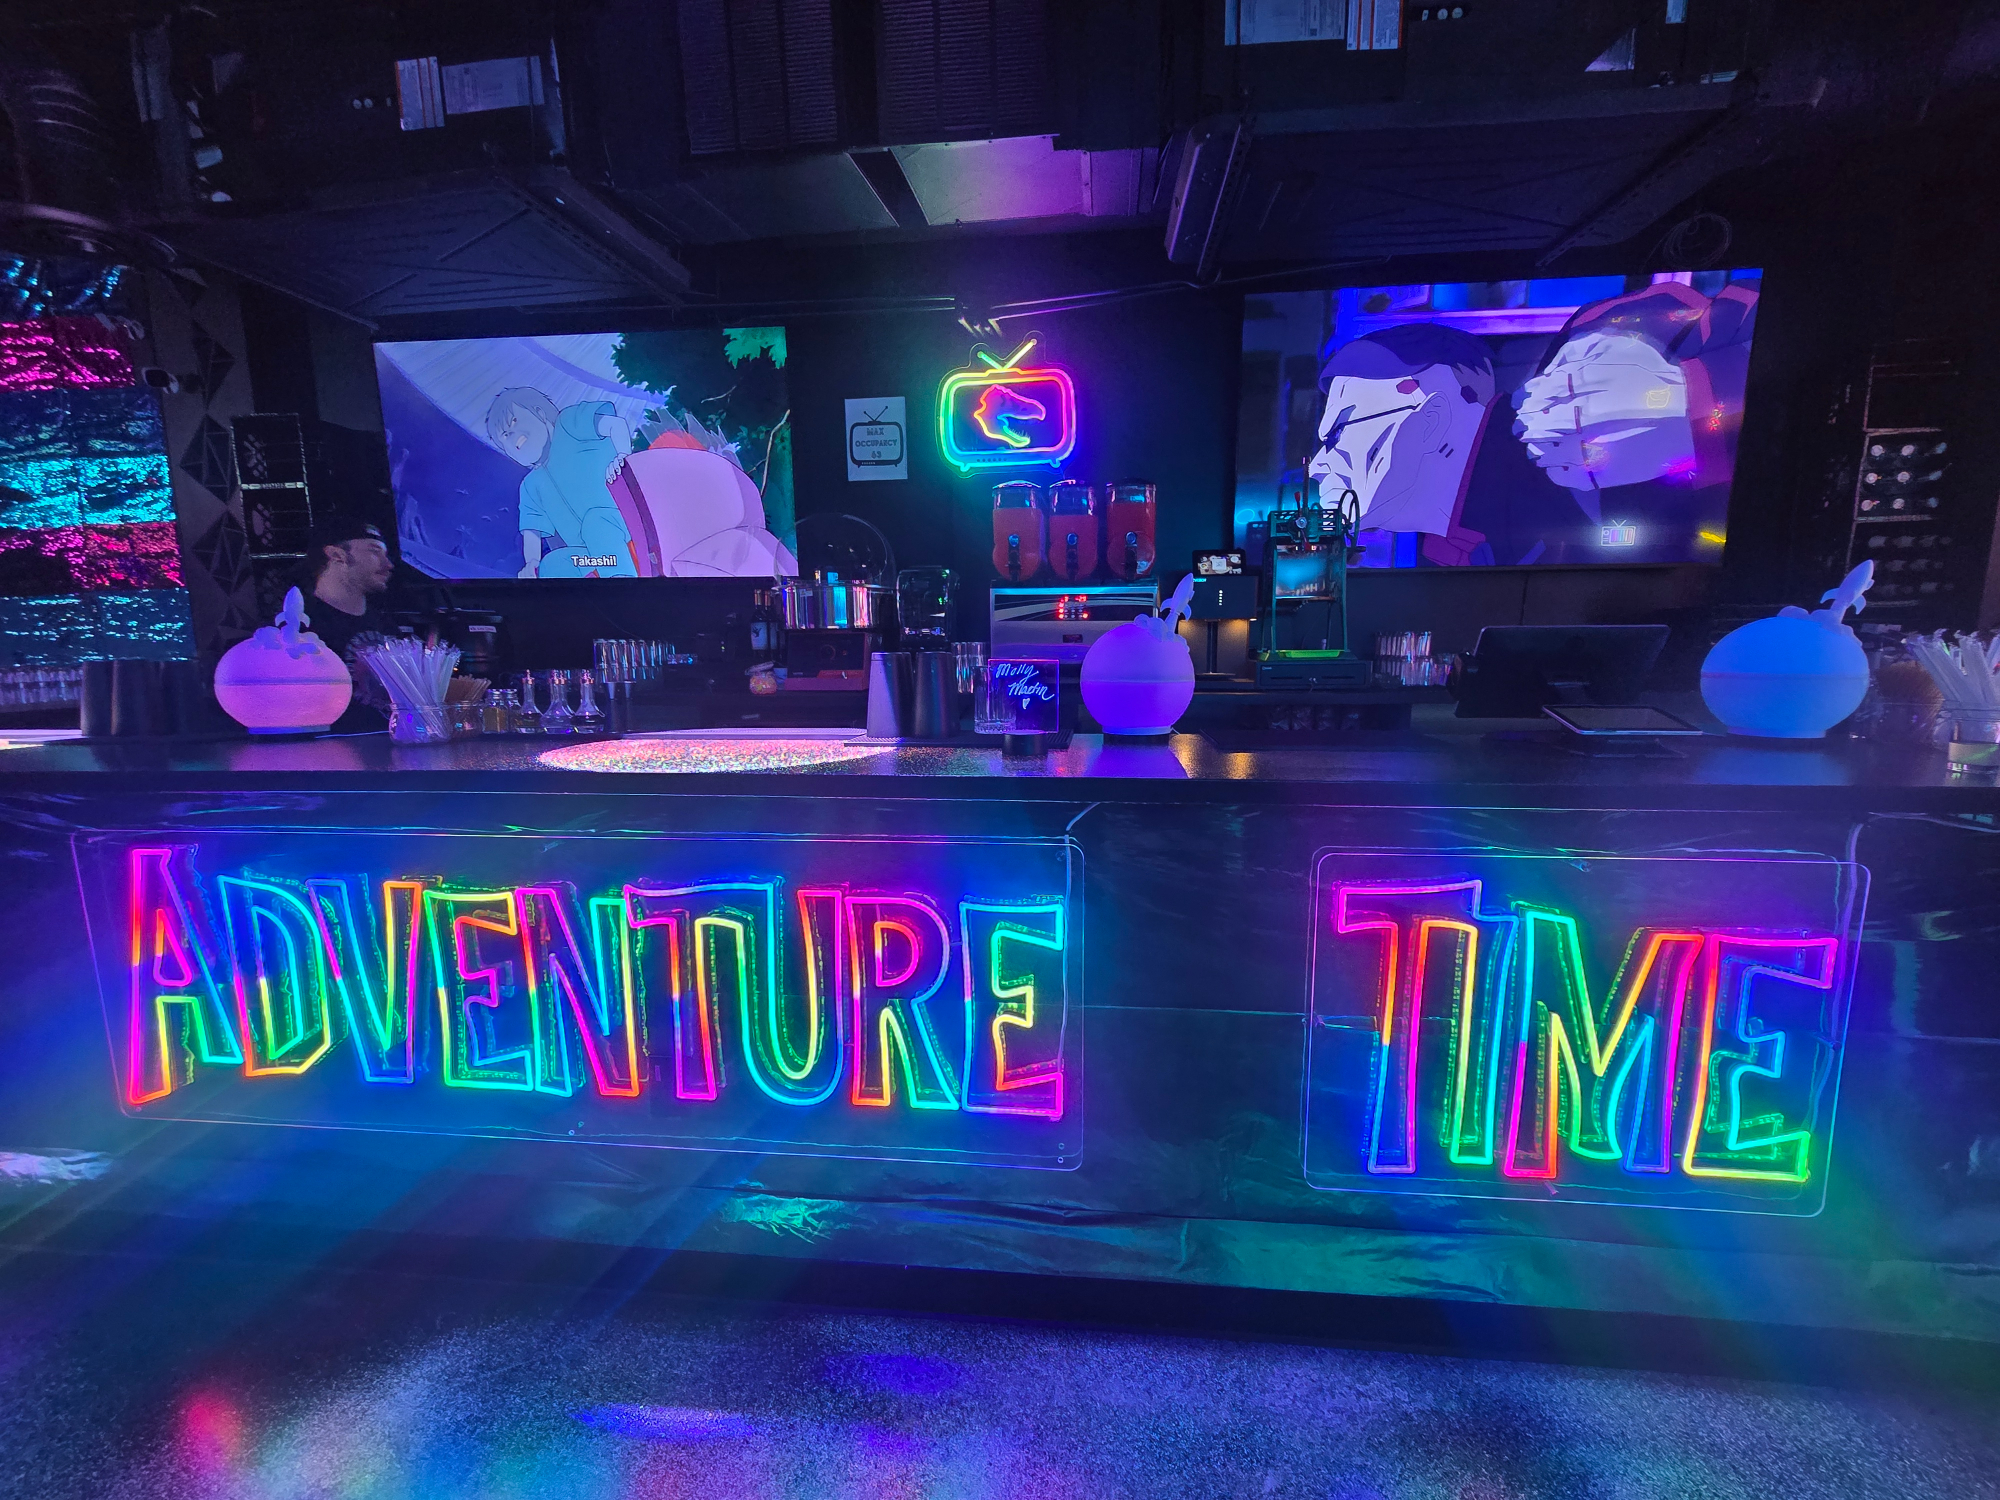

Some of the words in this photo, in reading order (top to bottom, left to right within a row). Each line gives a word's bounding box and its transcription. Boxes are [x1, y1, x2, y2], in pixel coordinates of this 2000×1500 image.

[866, 427, 885, 436] MAX
[855, 439, 898, 448] OCCUPANCY
[570, 555, 618, 567] Takashi!
[995, 663, 1039, 686] Molly
[126, 844, 1066, 1120] ADVENTURE
[1335, 877, 1839, 1183] TIME
